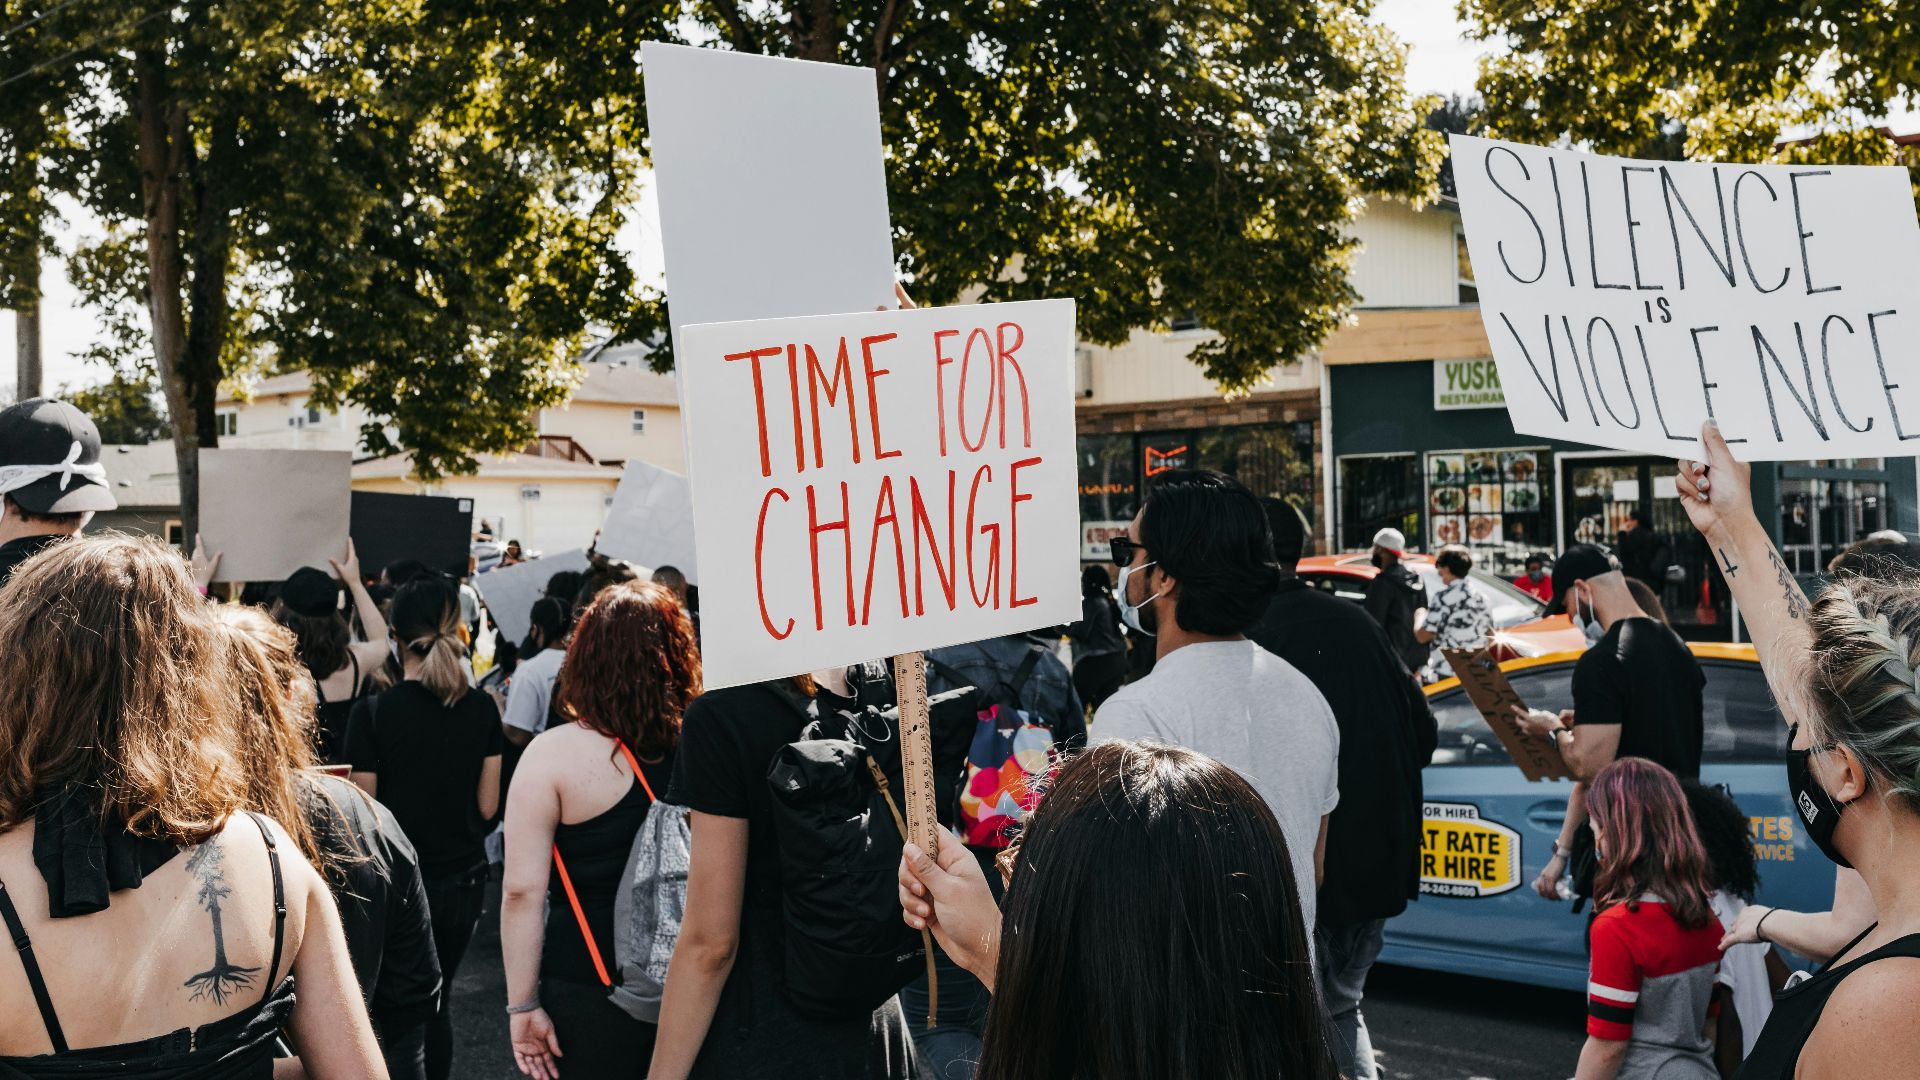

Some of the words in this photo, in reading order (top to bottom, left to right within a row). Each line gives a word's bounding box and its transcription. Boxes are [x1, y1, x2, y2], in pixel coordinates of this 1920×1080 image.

[1484, 146, 1842, 295] SILENCE
[1644, 296, 1672, 324] IS
[724, 332, 902, 477] TIME
[933, 322, 1032, 457] FOR
[1500, 309, 1920, 443] VIOLENCE
[755, 457, 1043, 641] CHANGE
[1445, 807, 1475, 819] HIRE
[1447, 831, 1500, 855] RATE
[1444, 855, 1496, 881] HIRE
